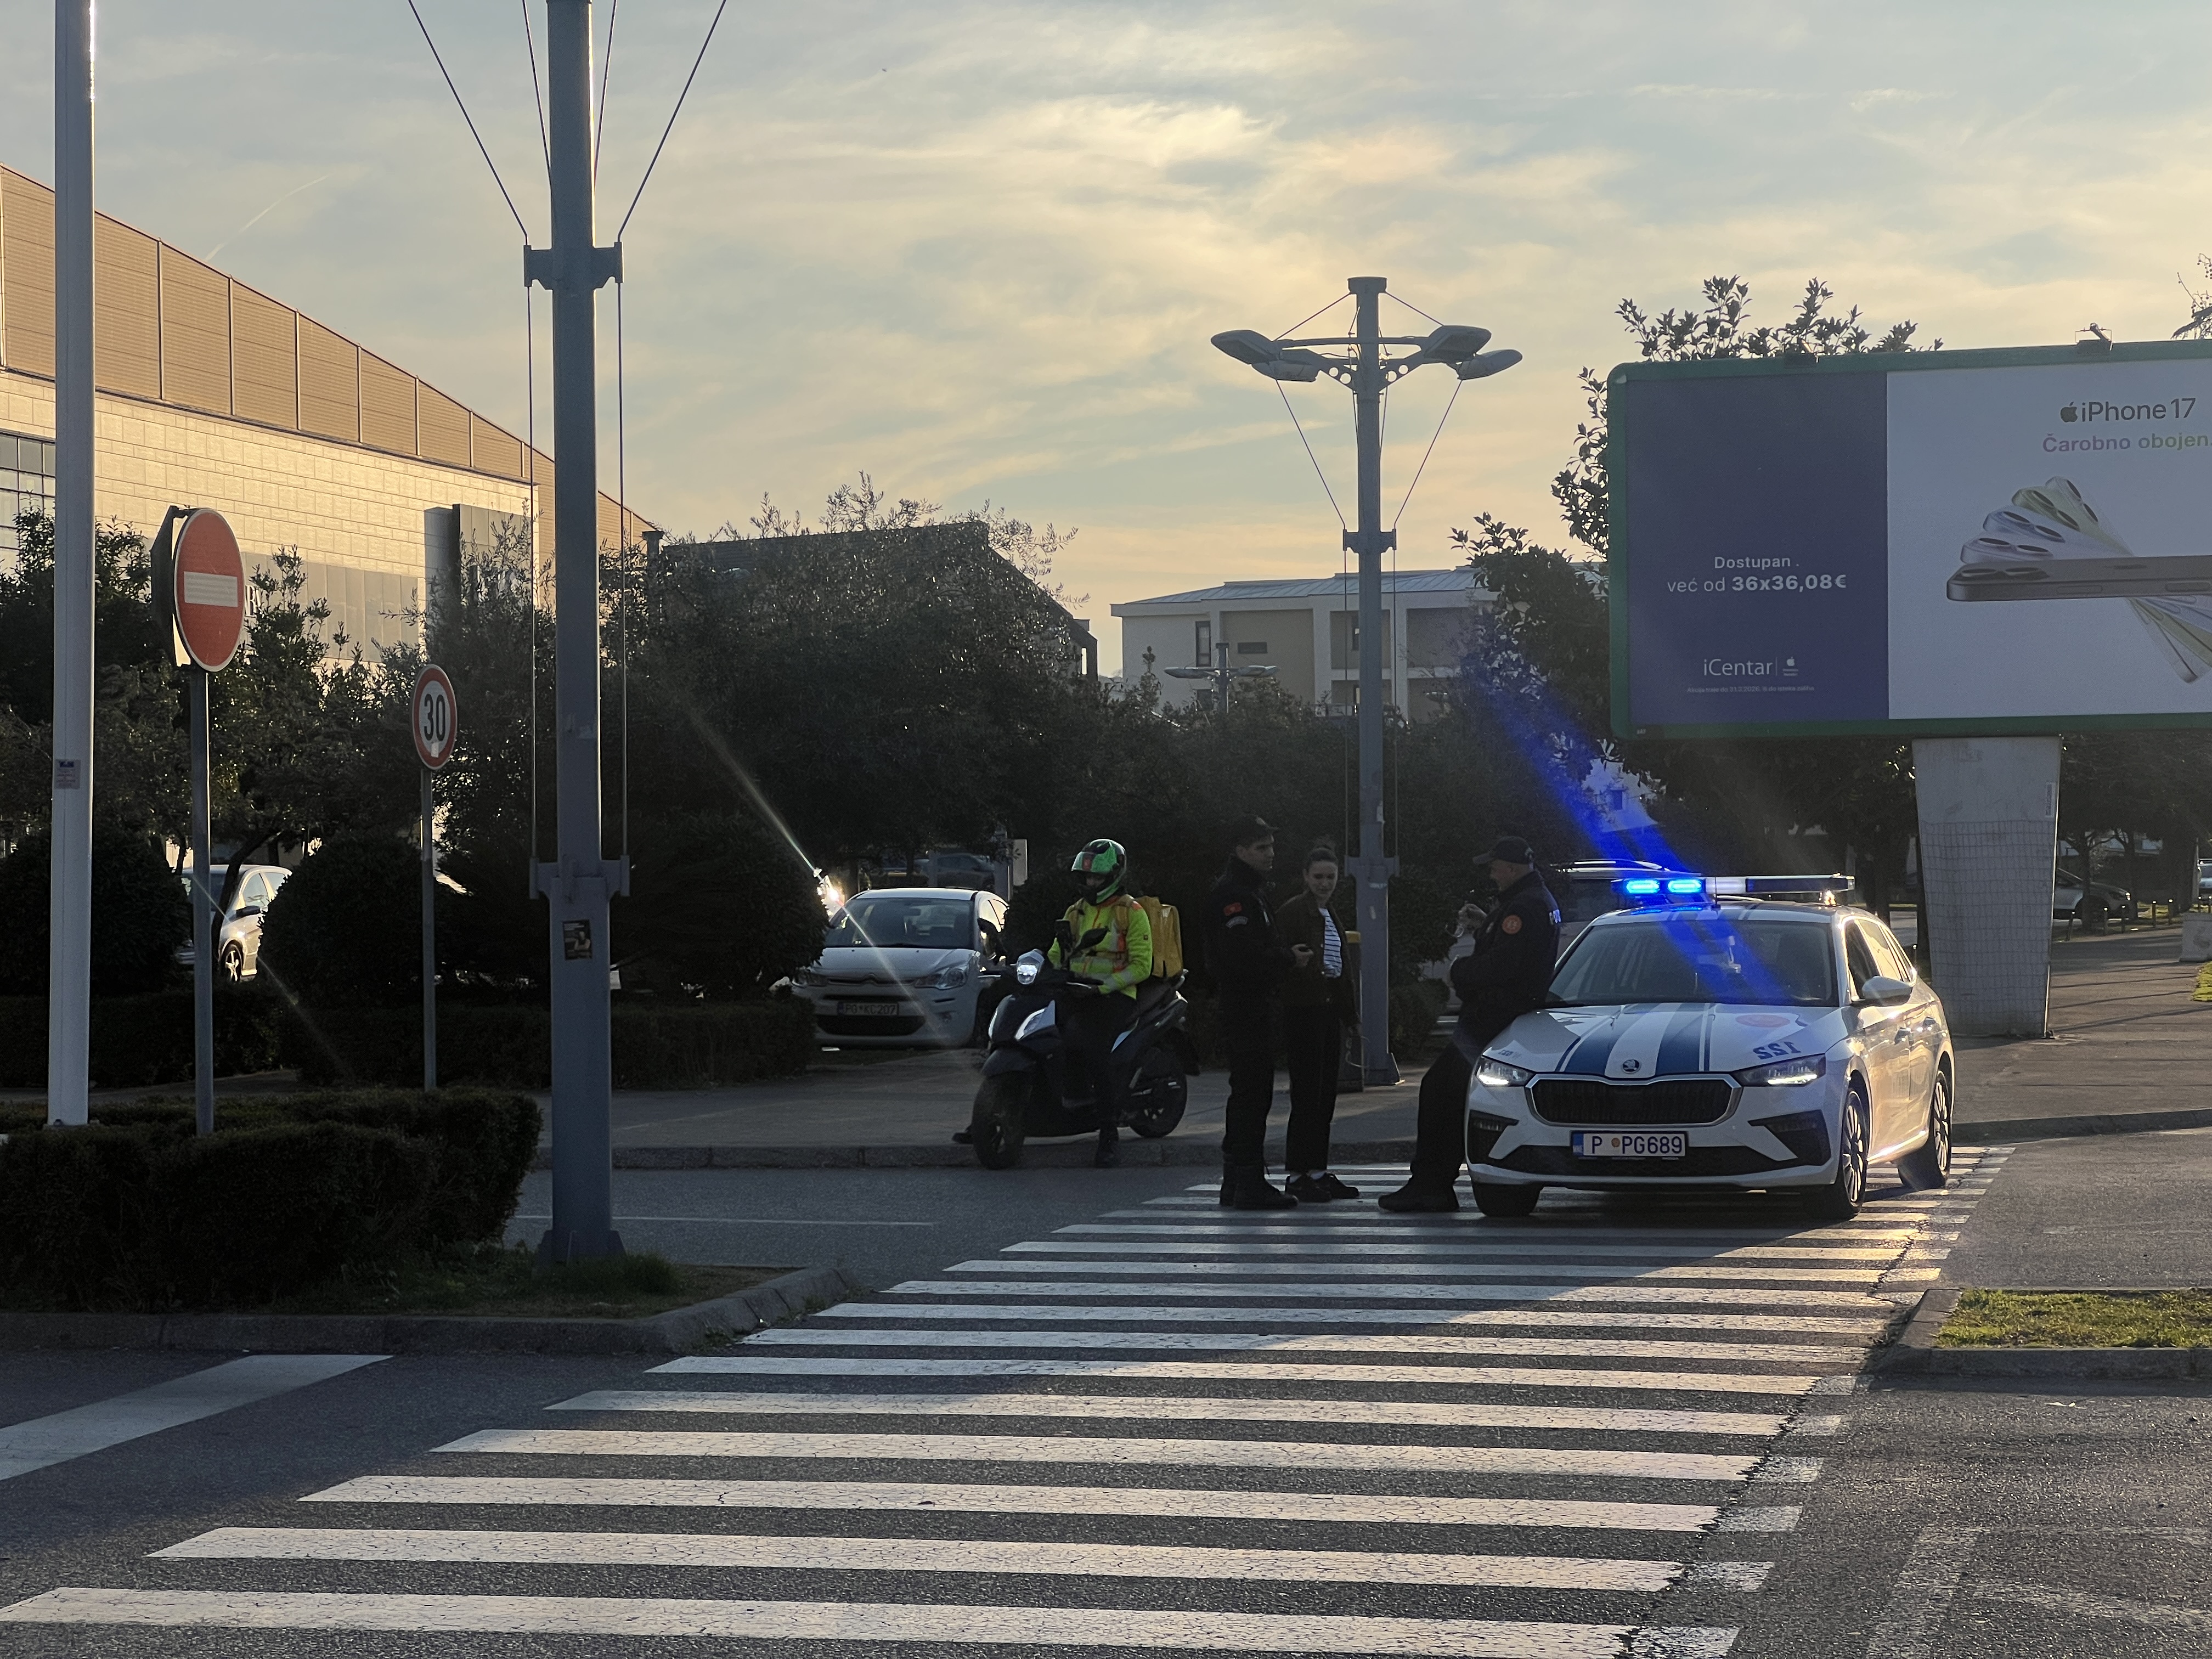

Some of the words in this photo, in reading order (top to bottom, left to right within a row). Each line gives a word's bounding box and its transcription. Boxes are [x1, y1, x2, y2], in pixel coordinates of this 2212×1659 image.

[2082, 401, 2166, 422] iPhone
[2170, 398, 2196, 419] 17
[2042, 433, 2131, 453] Čarobno
[1714, 556, 1791, 569] Dostupan
[1667, 578, 1698, 592] već
[1703, 577, 1725, 591] od
[1732, 574, 1847, 592] 36x36,08€
[1704, 659, 1773, 676] iCentar
[424, 693, 445, 741] 30
[1592, 1136, 1602, 1154] P
[1622, 1136, 1683, 1154] PG689
